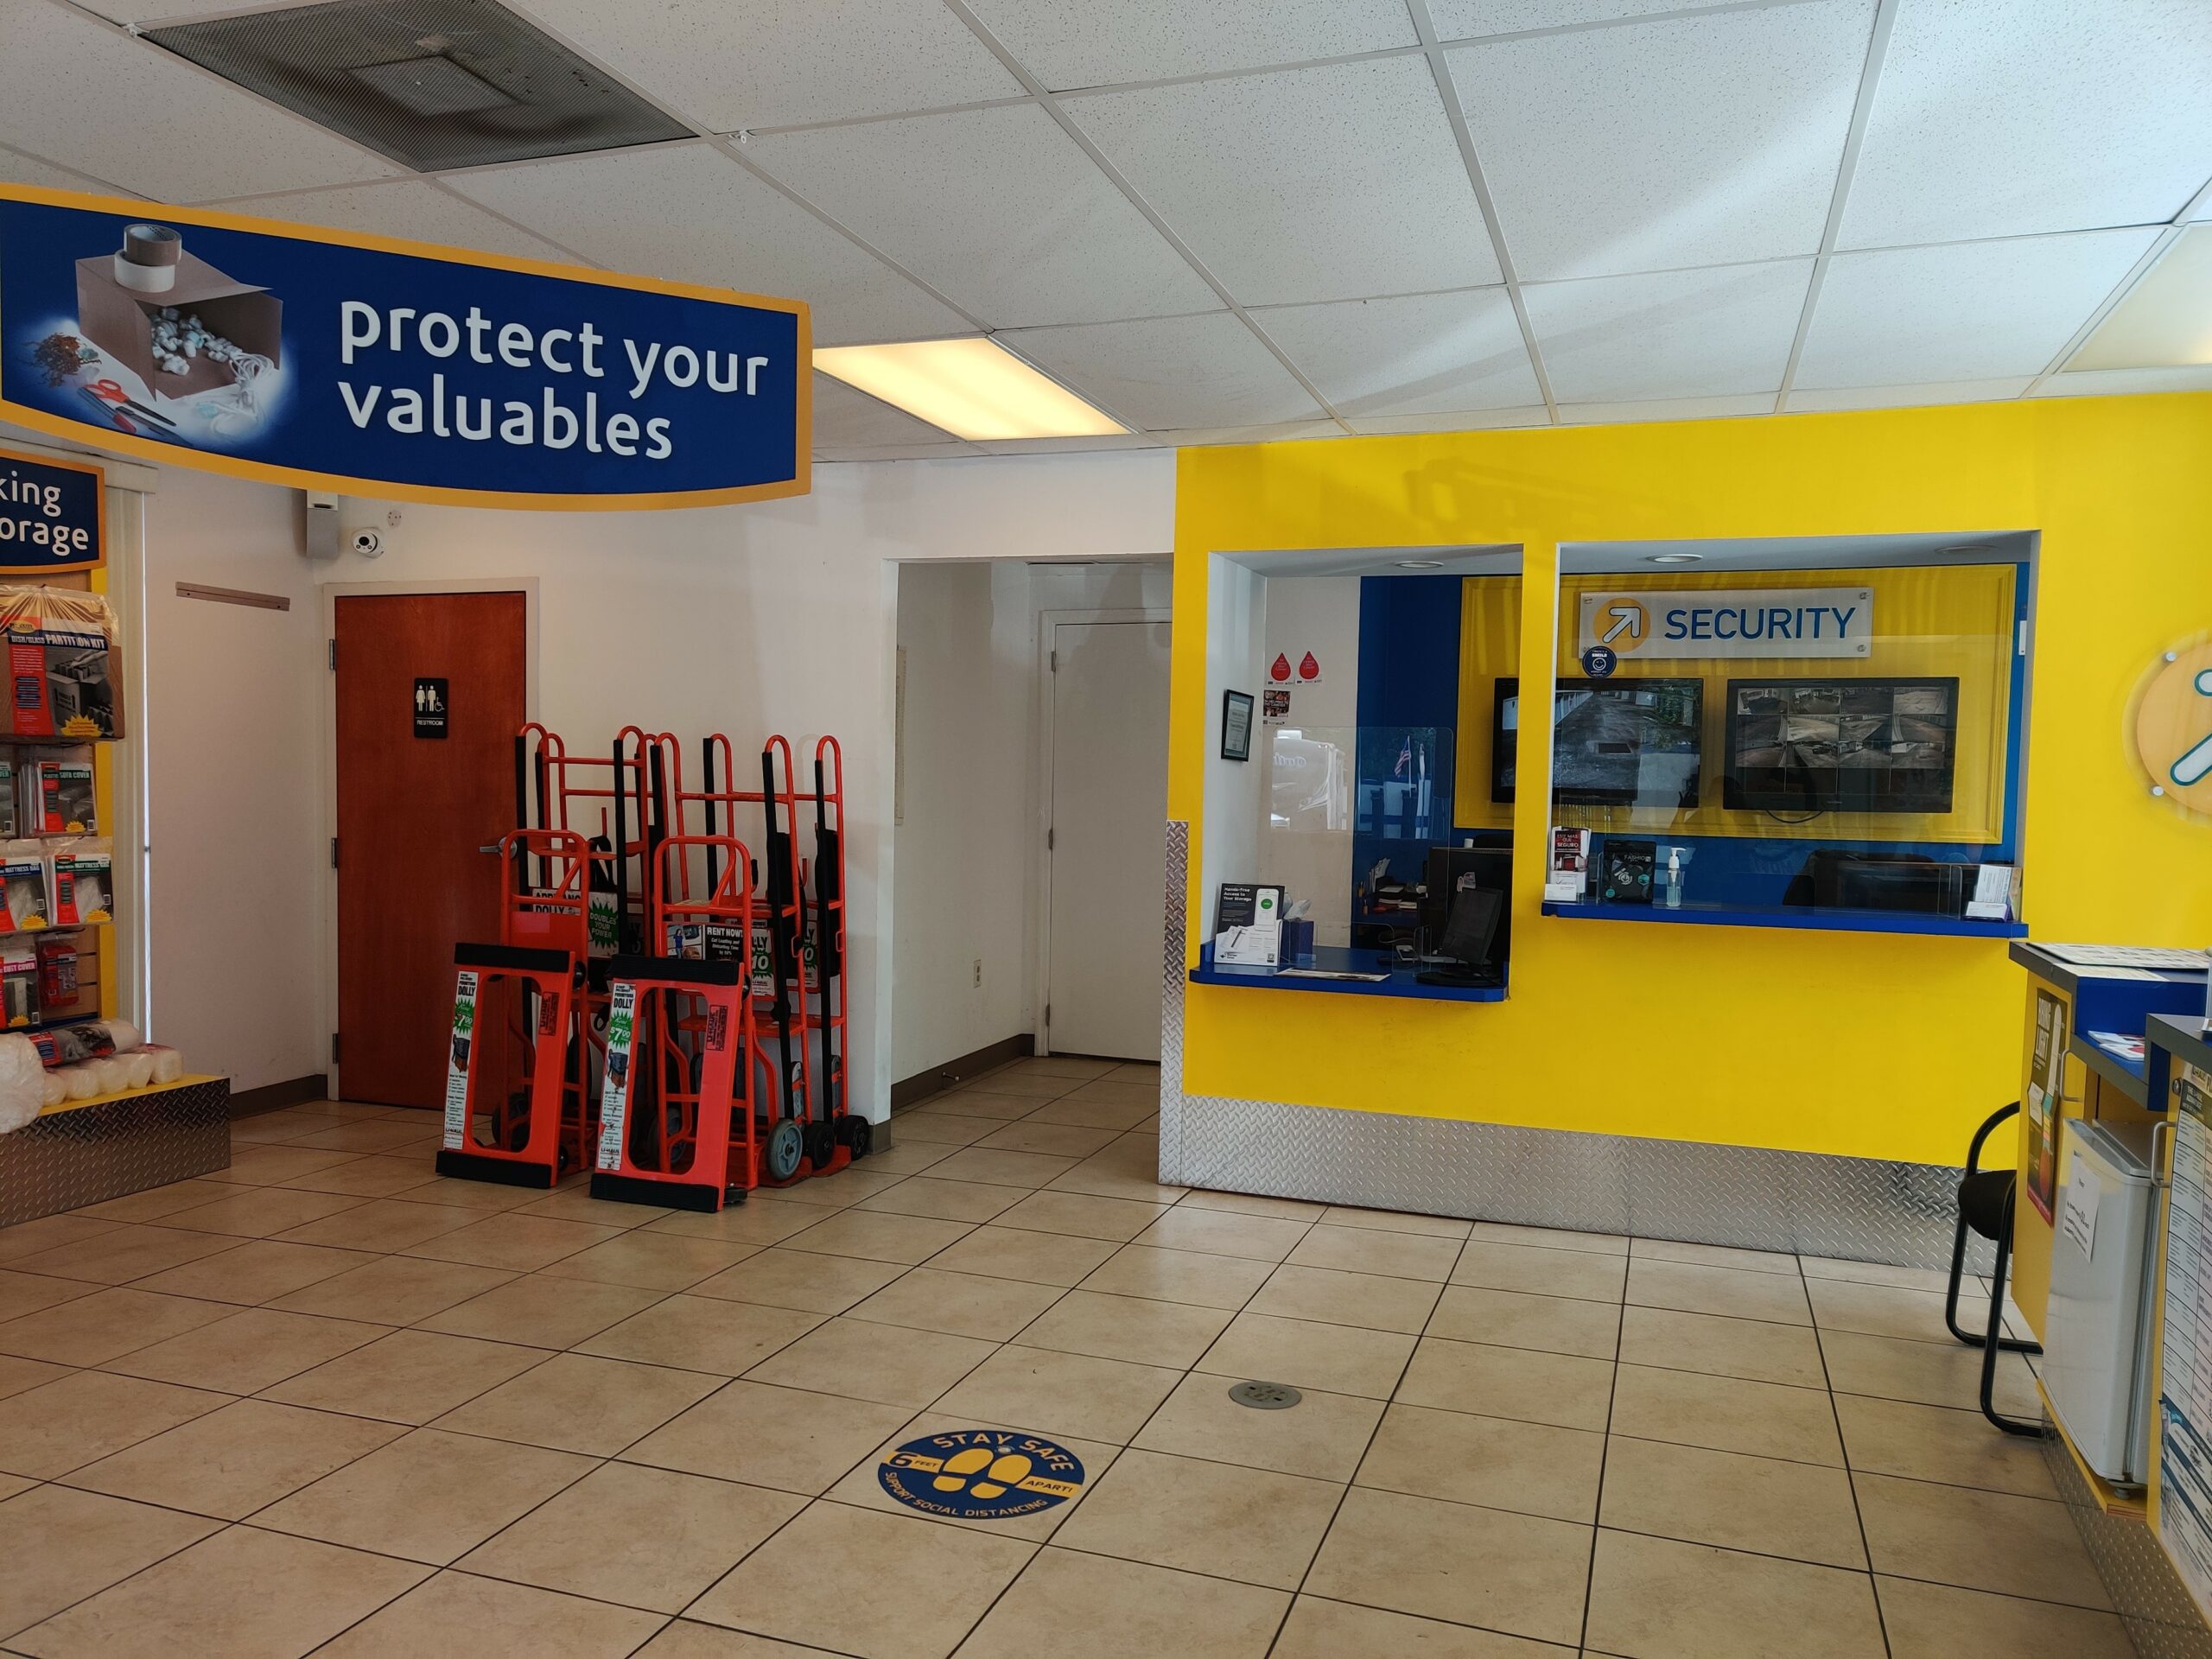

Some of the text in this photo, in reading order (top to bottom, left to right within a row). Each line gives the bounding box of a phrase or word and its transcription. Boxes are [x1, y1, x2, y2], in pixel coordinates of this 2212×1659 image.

[340, 301, 769, 400] protect your
[337, 372, 673, 460] valuables
[0, 517, 89, 556] orage
[1663, 607, 1857, 640] SECURITY
[92, 638, 105, 649] KIT
[589, 912, 617, 925] DOUBLES
[594, 920, 611, 931] YOUR
[707, 926, 726, 937] RENT
[591, 927, 613, 939] POWER
[752, 936, 768, 949] LLY
[457, 985, 476, 996] DOLLY
[613, 997, 634, 1009] DOLLY
[932, 1433, 1075, 1471] STAY SAFE
[889, 1452, 939, 1469] 6 FEET
[885, 1471, 1049, 1518] SUPPORT SOCIAL DISTANCING
